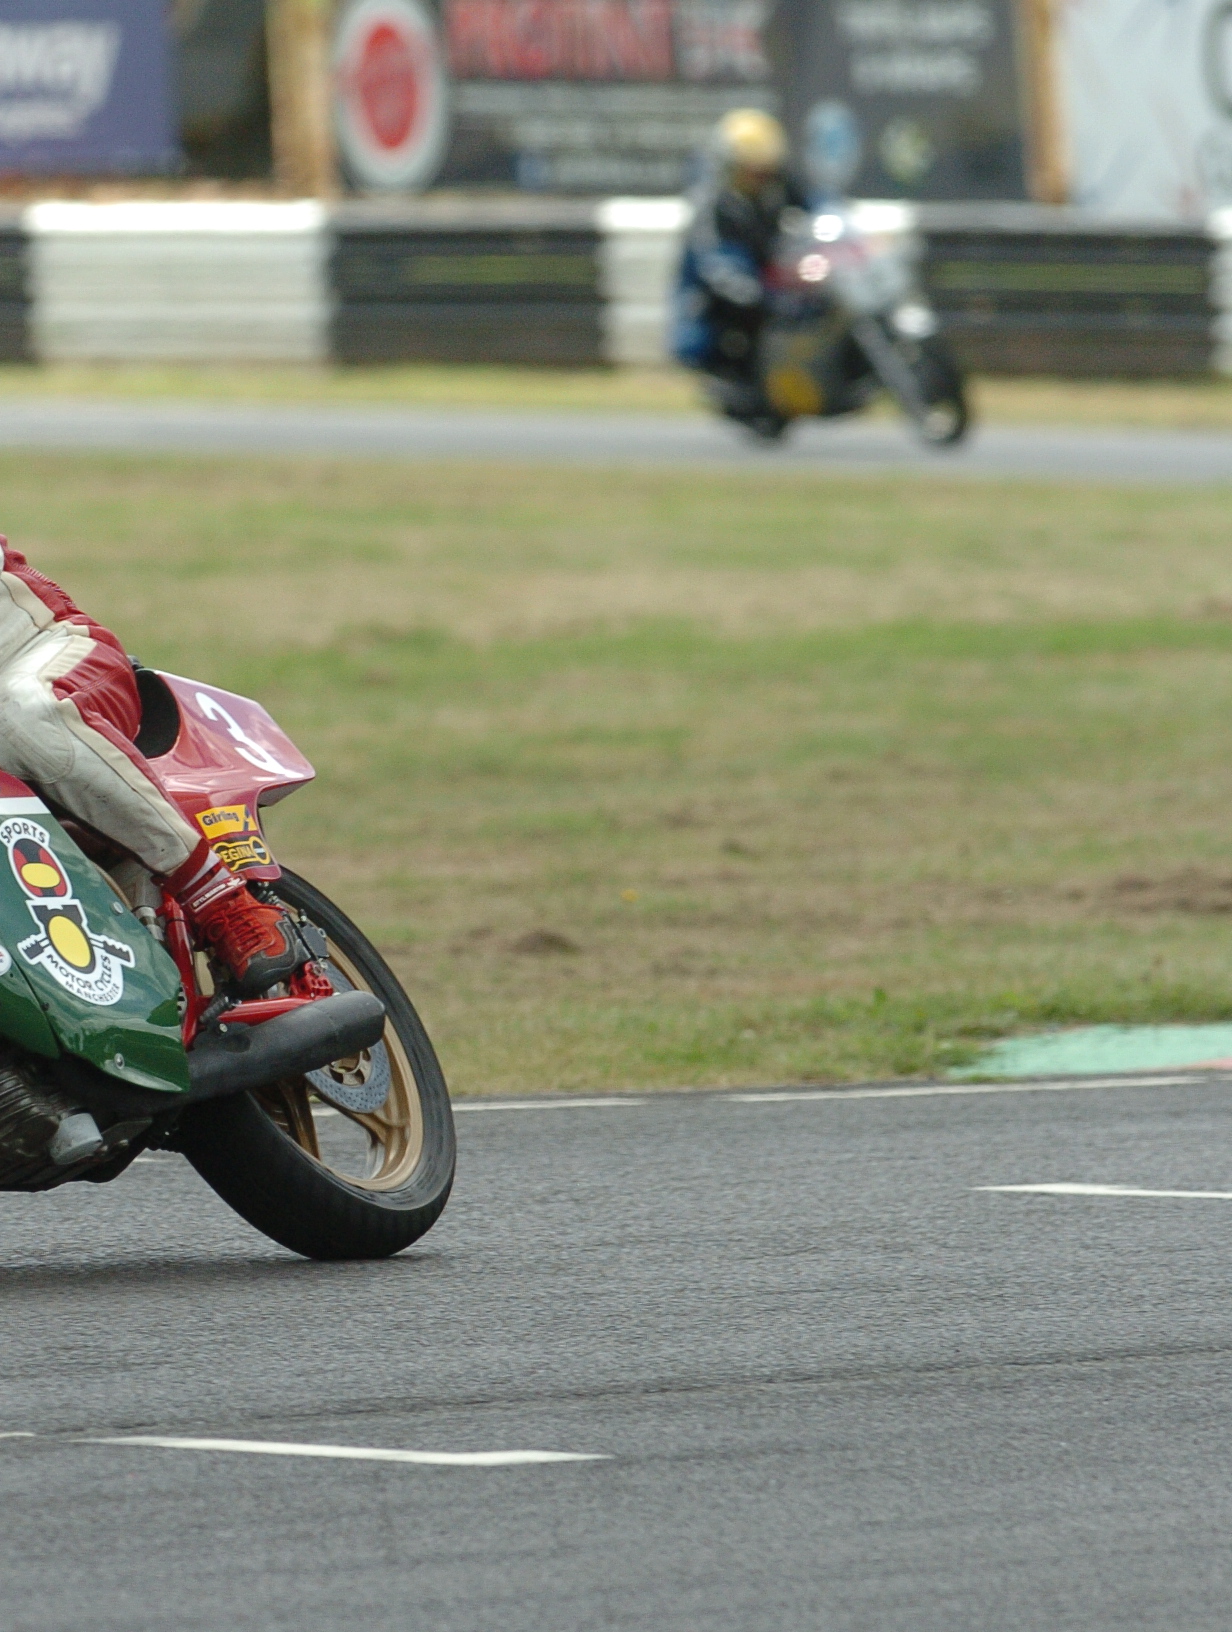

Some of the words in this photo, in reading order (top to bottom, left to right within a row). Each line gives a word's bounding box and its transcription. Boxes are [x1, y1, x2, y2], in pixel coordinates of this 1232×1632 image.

[195, 692, 285, 775] 3
[202, 811, 240, 827] Girling
[1, 822, 45, 844] SPORTS
[46, 954, 94, 991] MOTOR
[94, 954, 111, 991] CYCLES
[65, 980, 120, 1002] MANCHESTER
